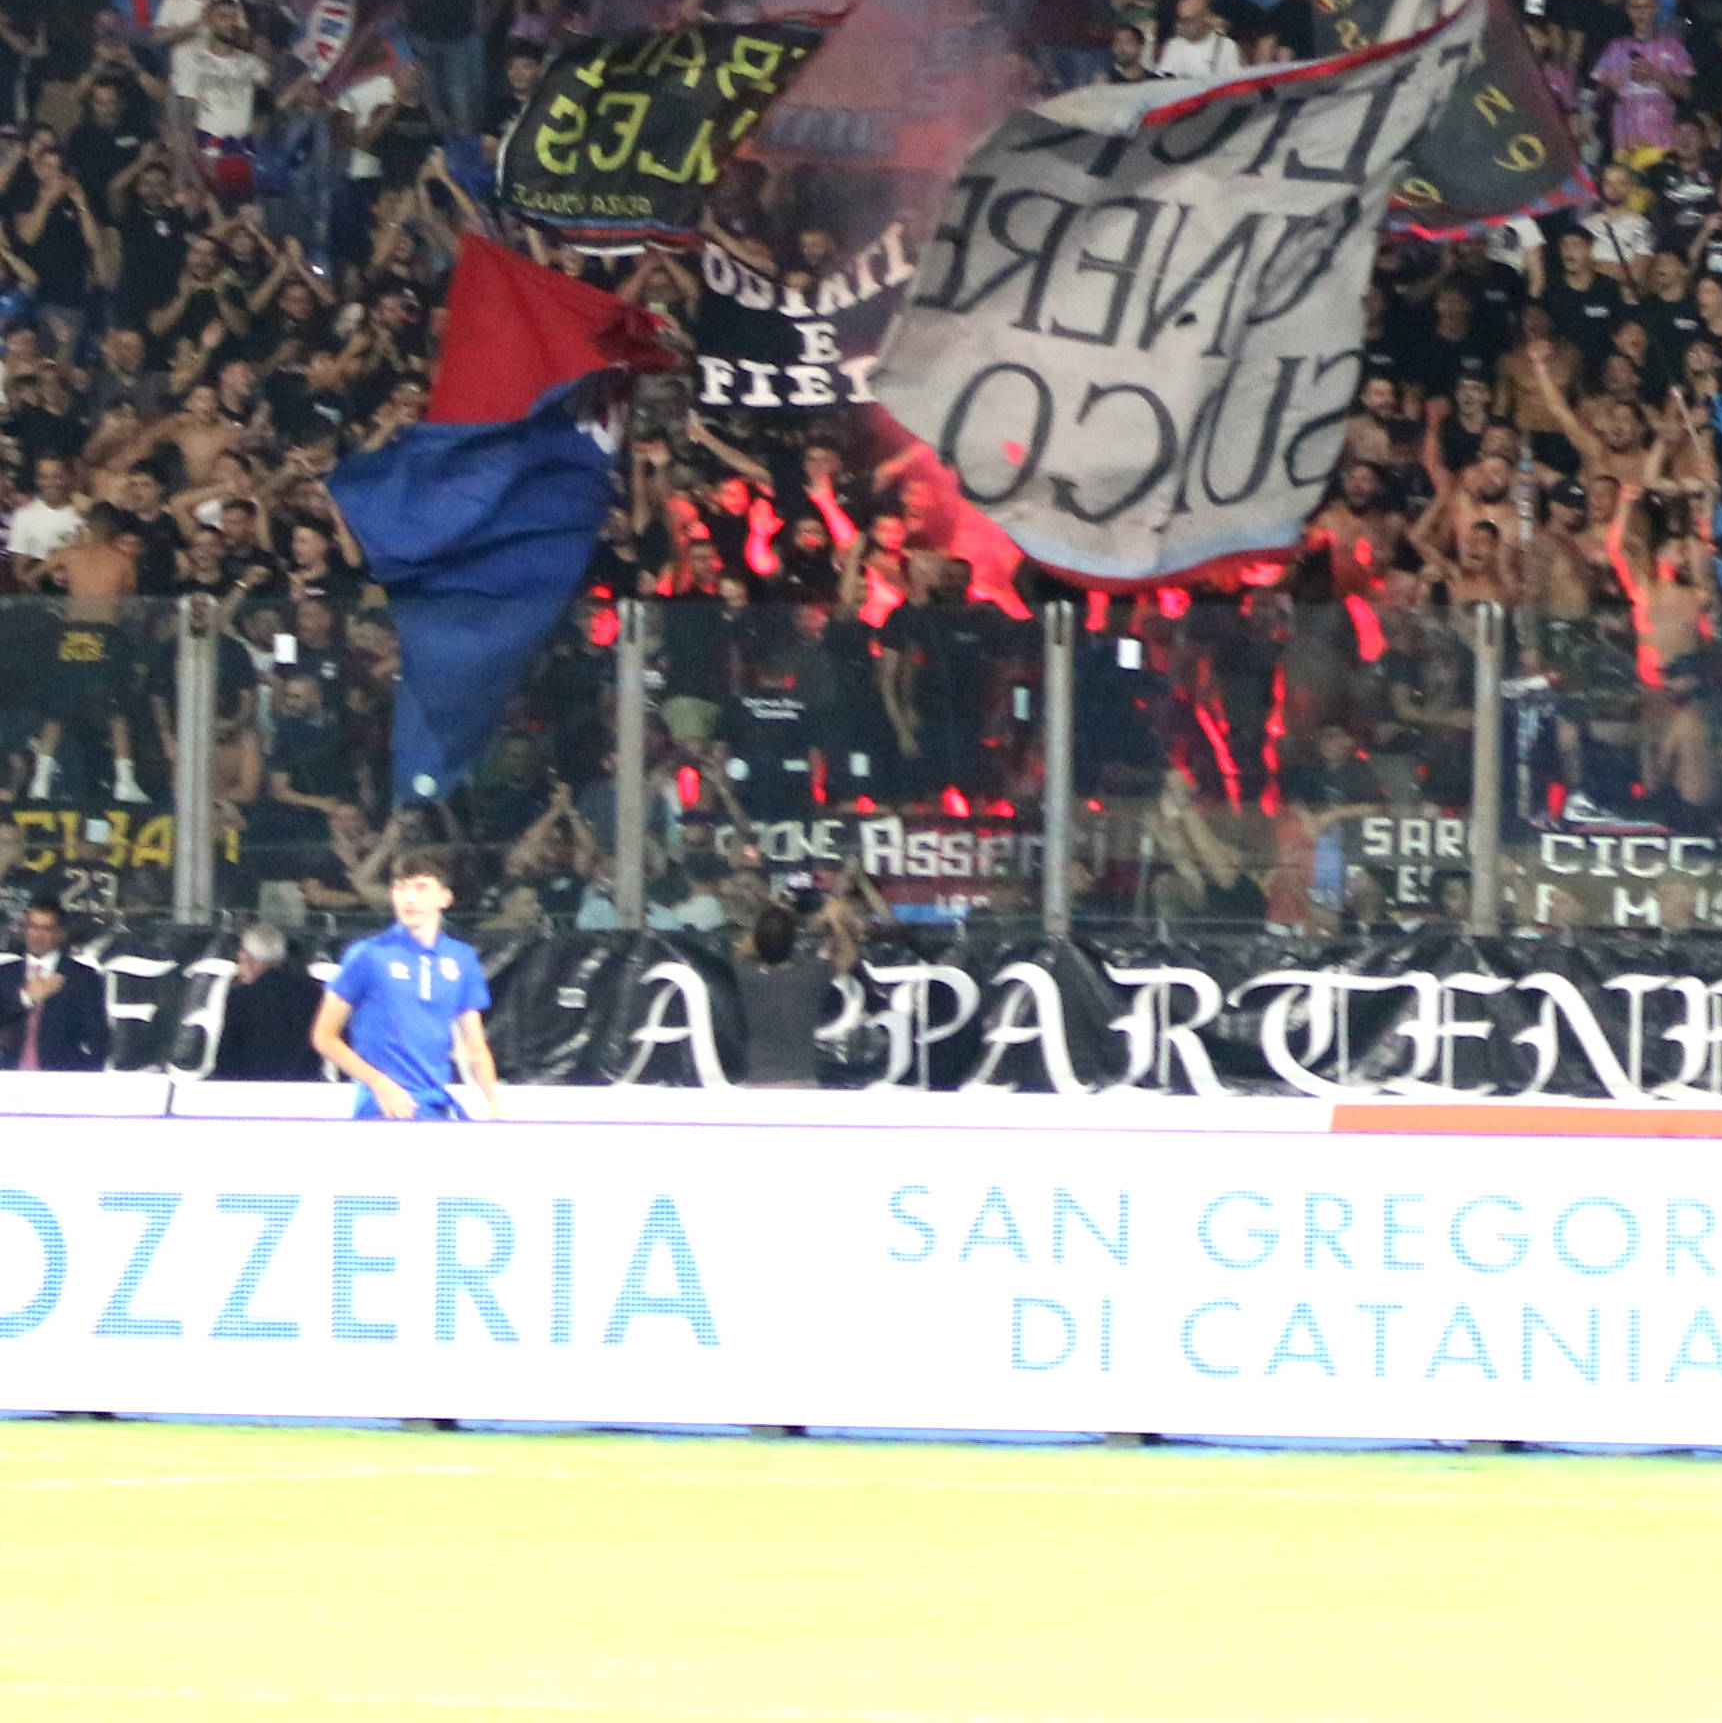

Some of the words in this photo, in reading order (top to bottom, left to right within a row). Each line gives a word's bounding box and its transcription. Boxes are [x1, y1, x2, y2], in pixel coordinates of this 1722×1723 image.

[792, 321, 844, 366] E
[885, 1184, 1130, 1266] SAN
[1010, 1294, 1111, 1374] DI
